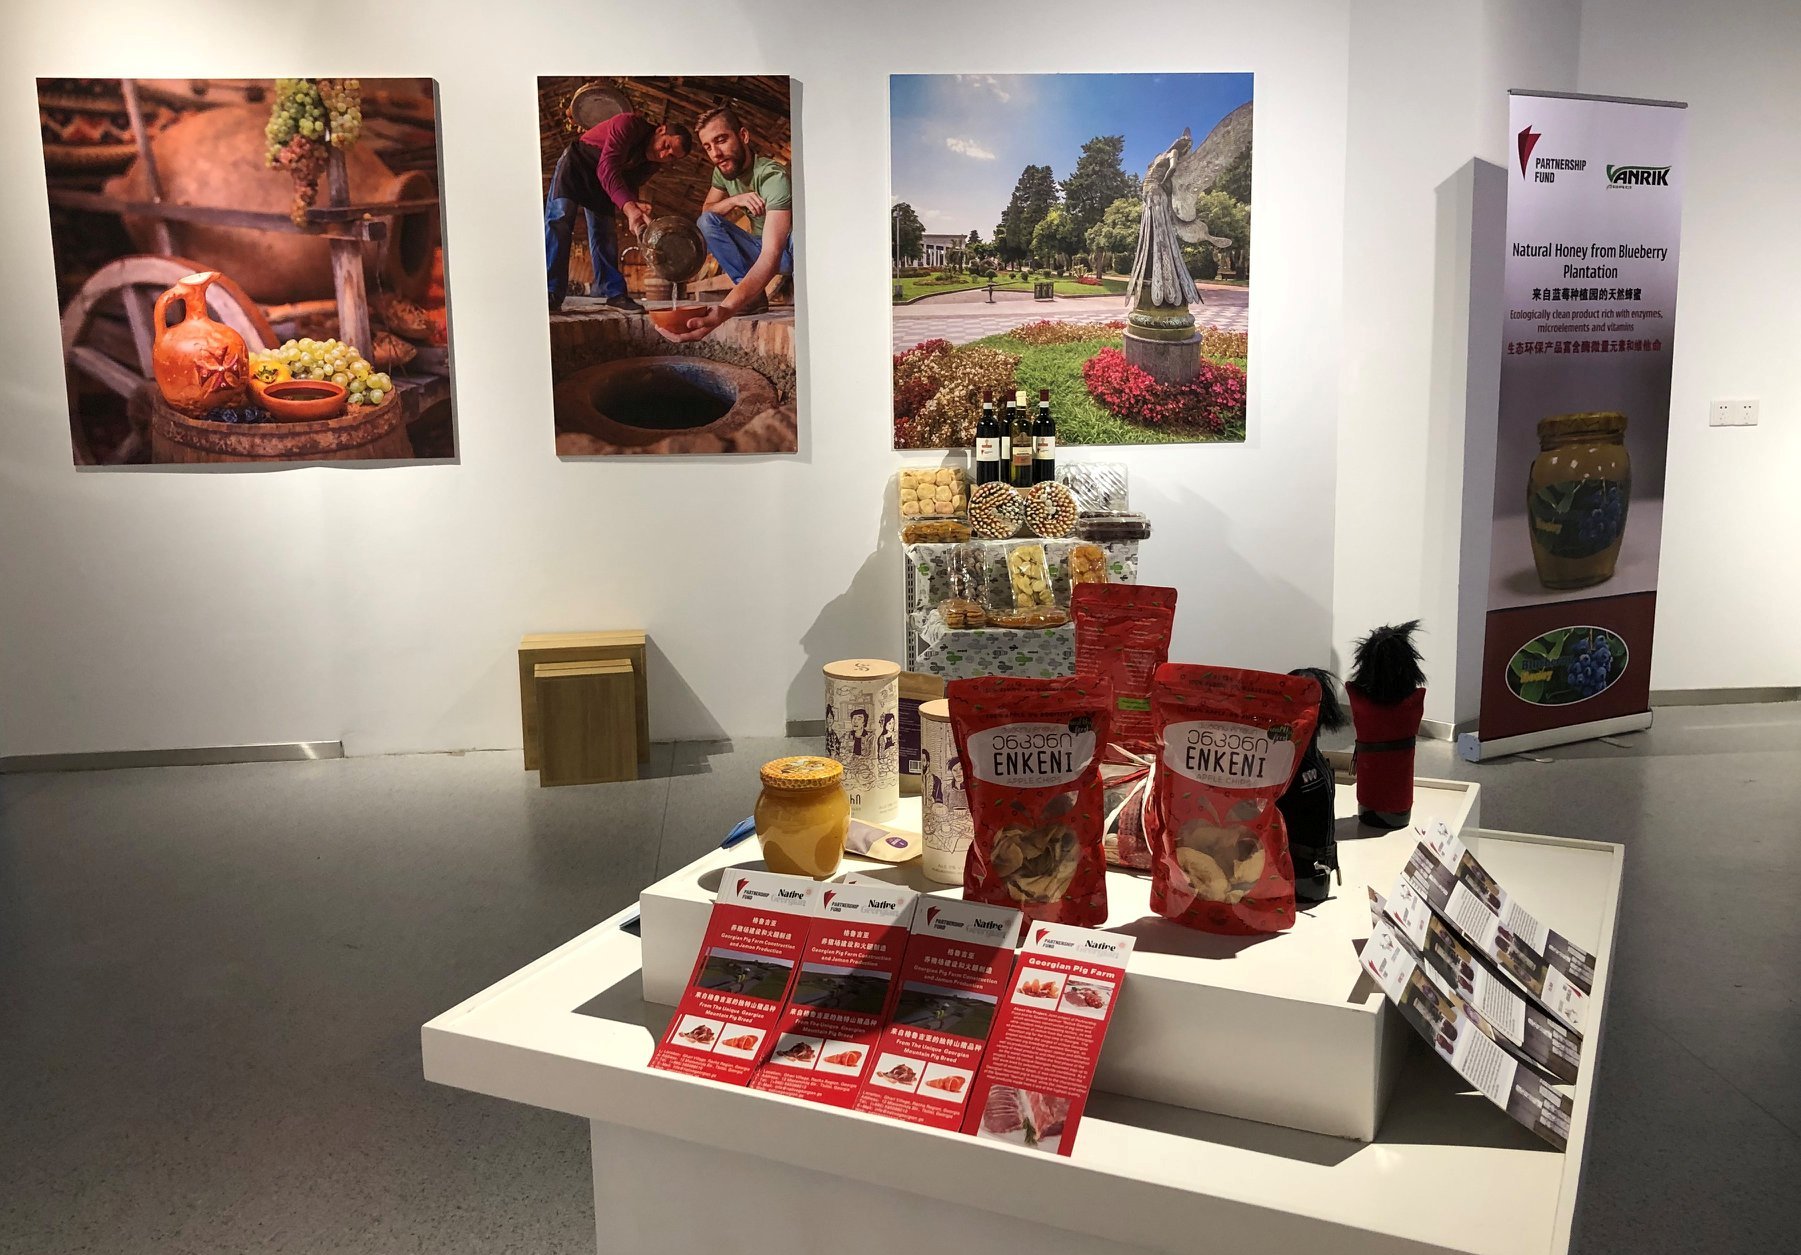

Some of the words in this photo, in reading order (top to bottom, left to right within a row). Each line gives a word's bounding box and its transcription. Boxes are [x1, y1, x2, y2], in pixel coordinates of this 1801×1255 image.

[1536, 158, 1586, 171] PARTNERSHIP
[1535, 172, 1554, 183] FUND
[1606, 165, 1672, 186] VANRIK
[1513, 243, 1551, 257] Natural
[1555, 244, 1588, 260] Honey
[1591, 243, 1616, 258] from
[1619, 245, 1667, 261] Blueberry
[1564, 264, 1617, 278] Plantation
[1532, 288, 1641, 301] 来自蓝莓种植园的天然蜂蜜
[1510, 309, 1550, 320] Ecologically
[1553, 309, 1570, 318] clean
[1572, 310, 1599, 320] product
[1602, 309, 1614, 318] rich
[1616, 309, 1629, 318] with
[1631, 311, 1663, 319] enzymes,
[1538, 323, 1589, 333] microelements
[1592, 323, 1605, 332] and
[1607, 323, 1634, 332] vitamins
[993, 733, 1072, 750] ენკენი
[1188, 730, 1268, 754] ენკენი
[994, 750, 1072, 775] ENKENI
[1186, 746, 1265, 778] ENKENI
[1196, 774, 1222, 782] APPLE
[778, 889, 804, 899] Native
[868, 899, 896, 910] Native
[935, 919, 964, 928] PARTNERSHIP
[974, 919, 1003, 931] Native
[765, 940, 795, 949] Construction
[1044, 938, 1075, 947] PARTNERSHIP
[1085, 940, 1116, 952] Native
[756, 946, 782, 954] Production
[812, 947, 834, 955] Georgian
[1029, 958, 1071, 970] Georgian
[1073, 965, 1088, 974] Pig
[1090, 968, 1115, 978] Farm
[705, 1010, 728, 1019] Mountain
[722, 1006, 740, 1014] Unique
[741, 1010, 764, 1019] Georgian
[904, 1047, 930, 1058] Mountain
[931, 1053, 940, 1061] Pig
[941, 1055, 957, 1063] Breed
[922, 1044, 941, 1053] Unique
[944, 1048, 970, 1059] Georgian
